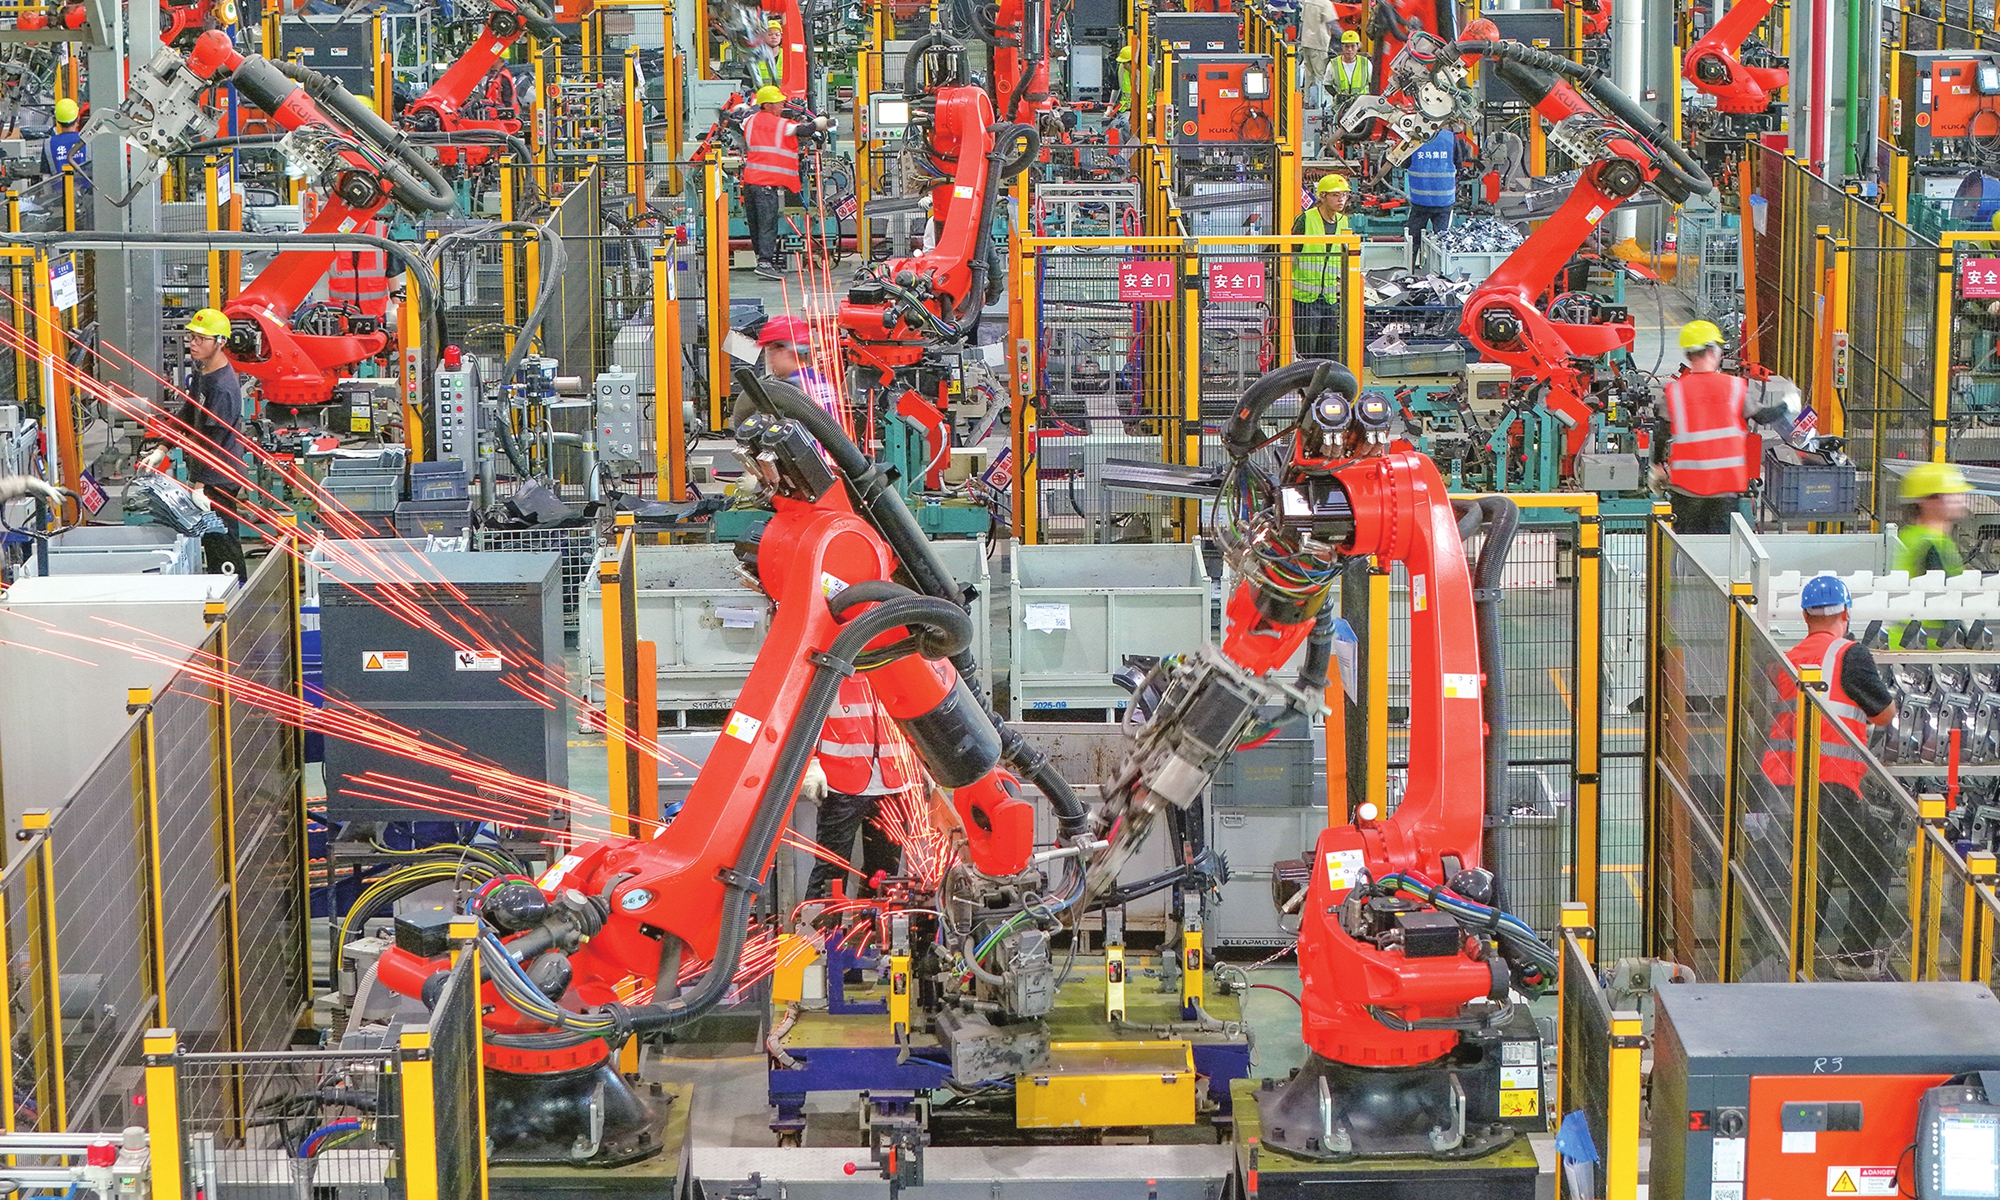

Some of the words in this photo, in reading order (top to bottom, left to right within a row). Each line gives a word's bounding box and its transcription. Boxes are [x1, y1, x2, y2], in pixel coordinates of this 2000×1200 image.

[1417, 151, 1448, 160] 安马集团
[1123, 273, 1170, 288] 安全门
[1213, 274, 1261, 289] 安全门
[1967, 269, 1999, 285] 安全
